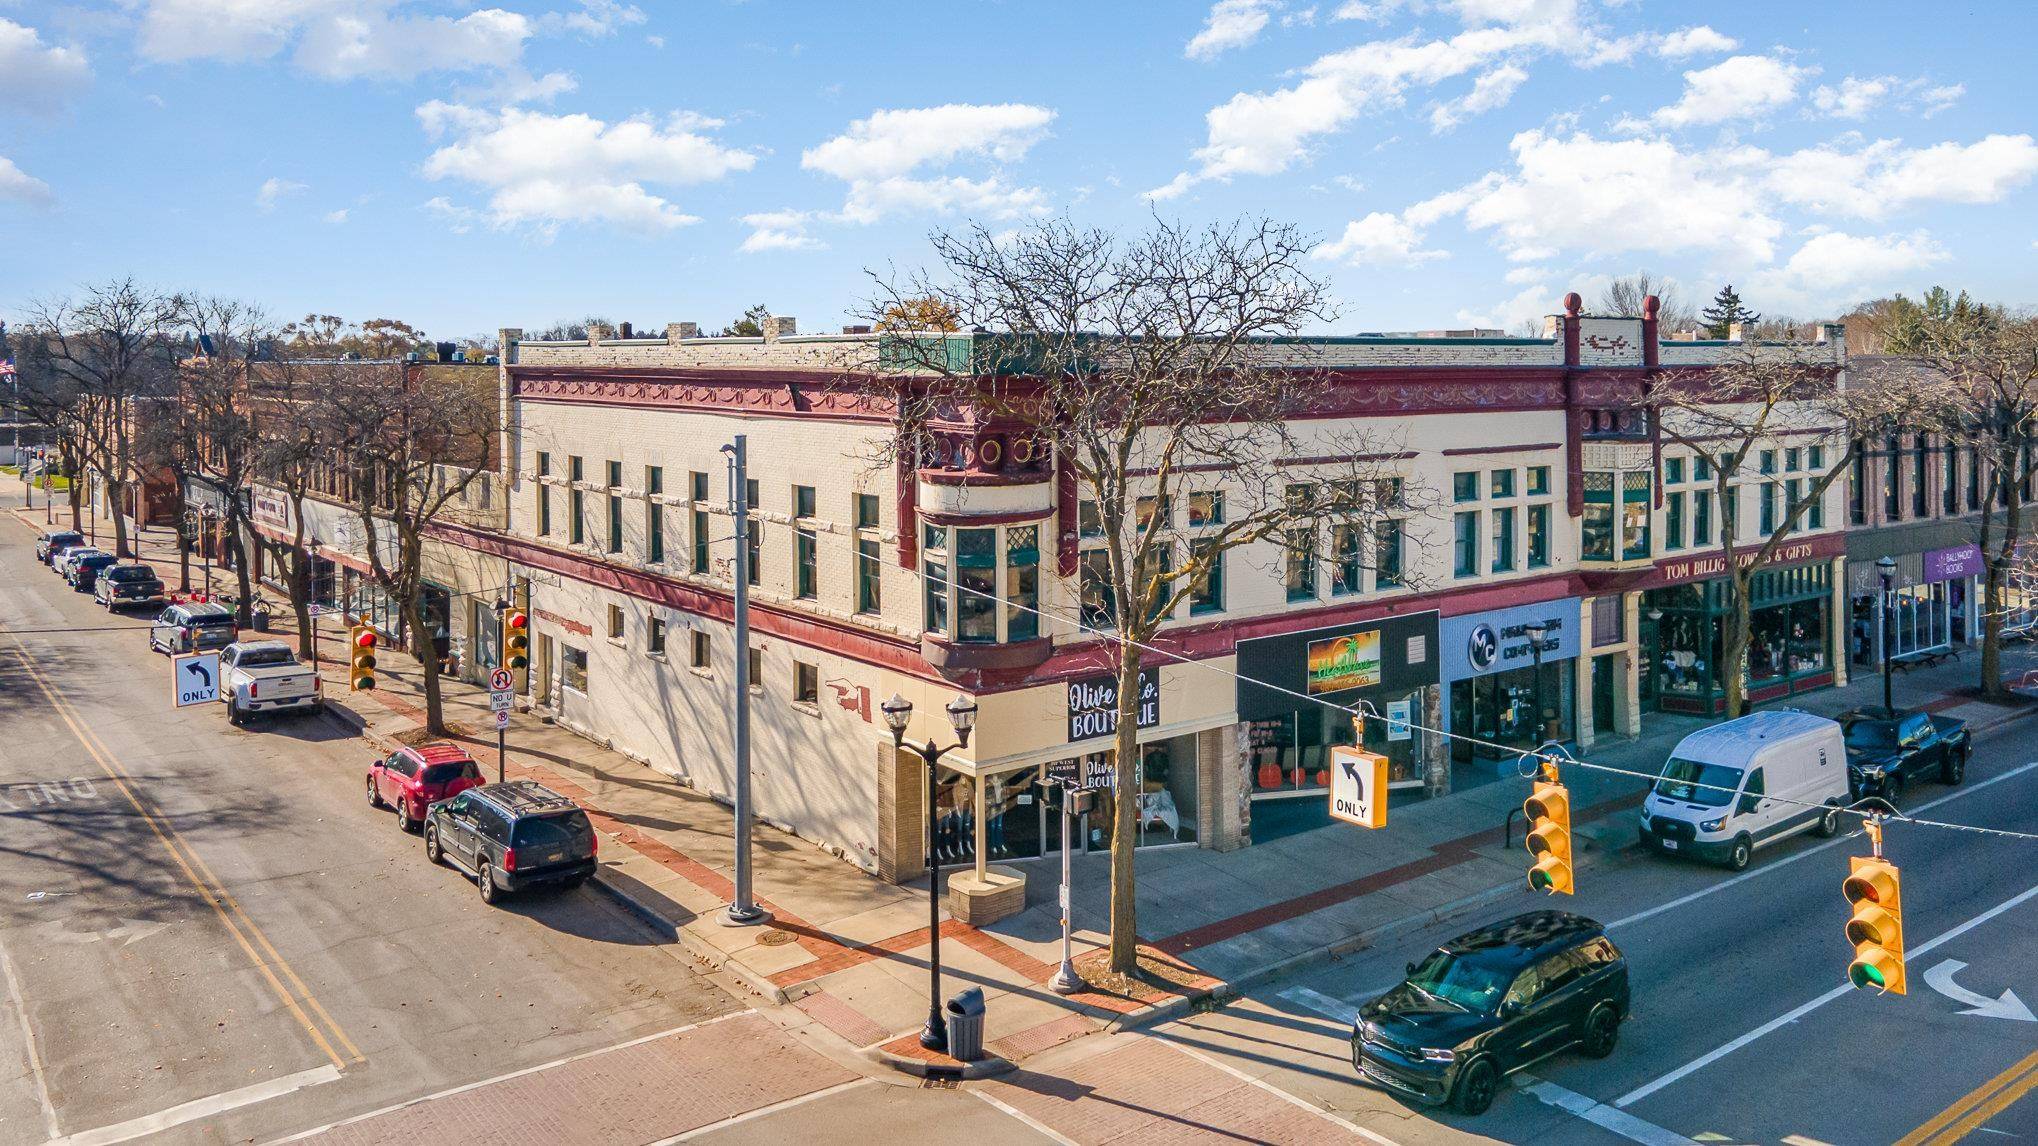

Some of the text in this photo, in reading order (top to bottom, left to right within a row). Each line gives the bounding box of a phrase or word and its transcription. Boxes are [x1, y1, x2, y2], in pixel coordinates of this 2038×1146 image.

[1666, 563, 1689, 579] TOM
[1694, 558, 1725, 574] BILLIG
[1775, 549, 1781, 561] &
[1786, 543, 1811, 559] GIFTS
[183, 688, 215, 702] ONLY
[1069, 683, 1115, 711] Olive
[1073, 702, 1156, 738] BOUTUE
[1086, 761, 1114, 775] Olive
[1337, 799, 1367, 818] ONLY
